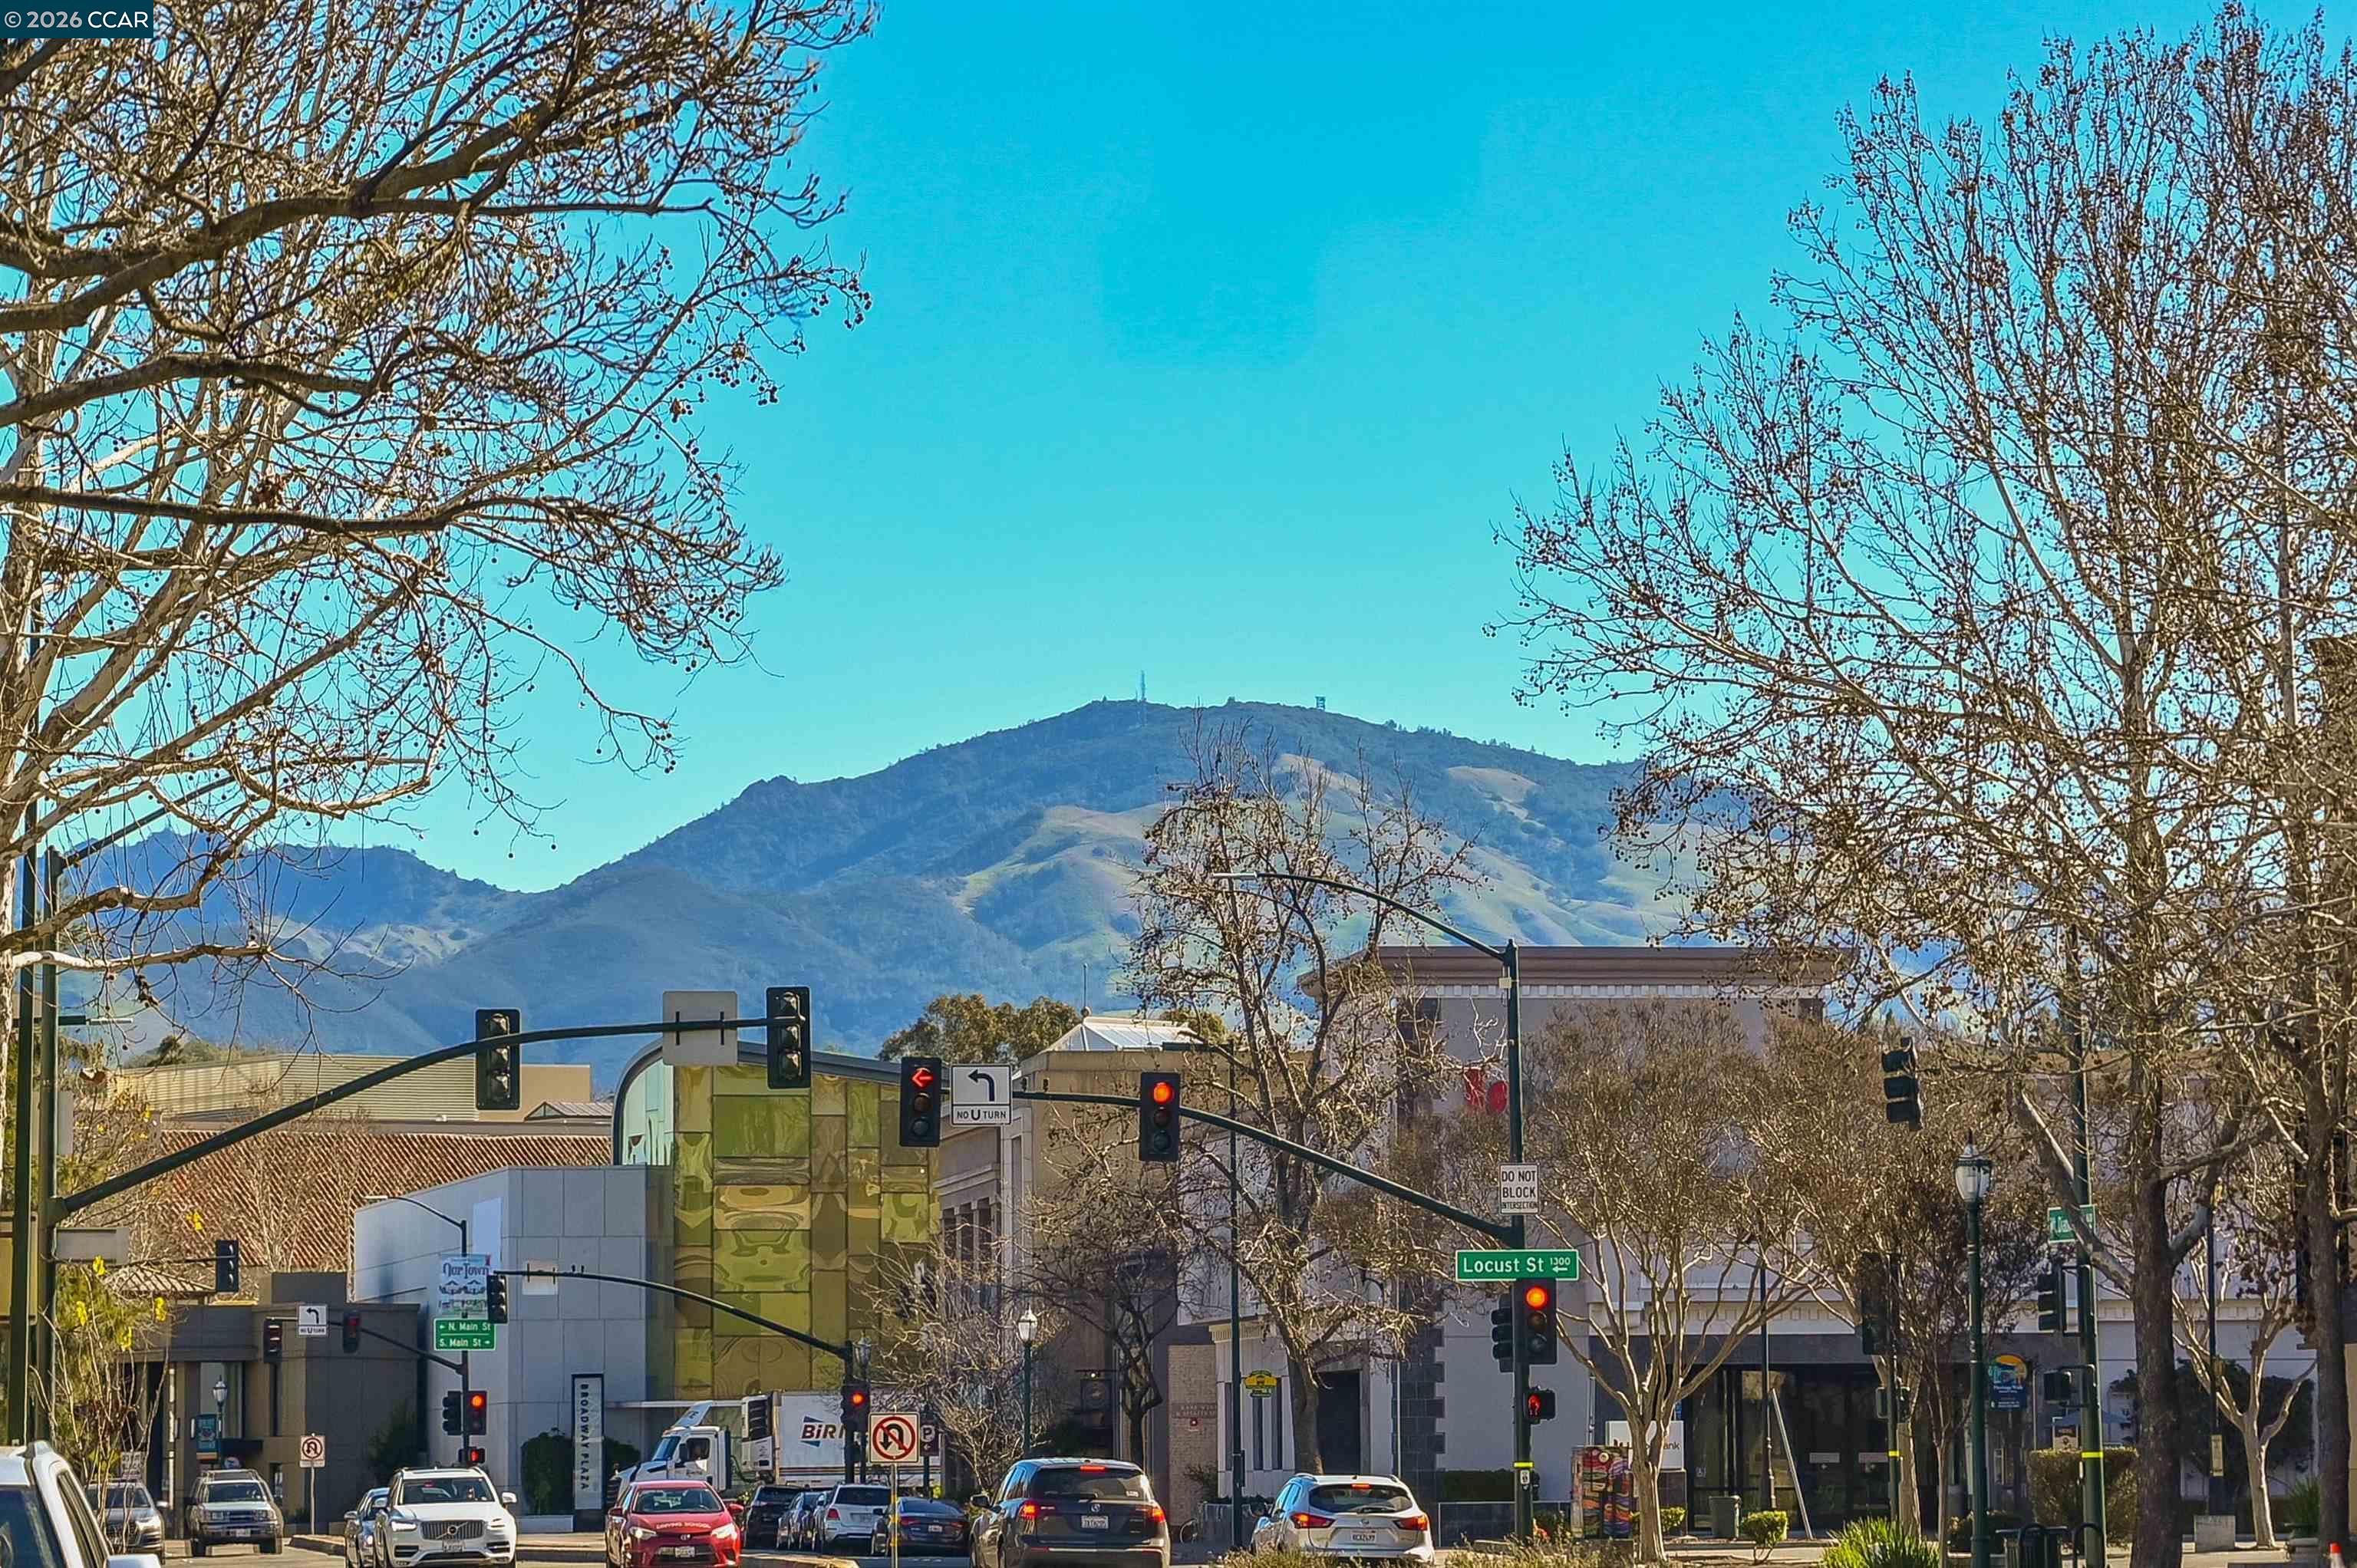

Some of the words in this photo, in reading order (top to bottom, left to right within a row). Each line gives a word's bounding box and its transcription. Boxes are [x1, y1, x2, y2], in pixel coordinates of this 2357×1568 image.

[971, 1109, 981, 1120] U
[1502, 1171, 1515, 1181] DO
[1518, 1171, 1536, 1181] NOT
[1502, 1187, 1536, 1197] BLOCK
[1463, 1257, 1520, 1273] Locust
[1526, 1257, 1544, 1273] St
[460, 1323, 478, 1331] Main
[482, 1323, 490, 1331] St
[450, 1339, 468, 1347] Main
[473, 1339, 481, 1347] St
[581, 1384, 589, 1448] BROADWAY
[581, 1453, 589, 1490] PLAZA
